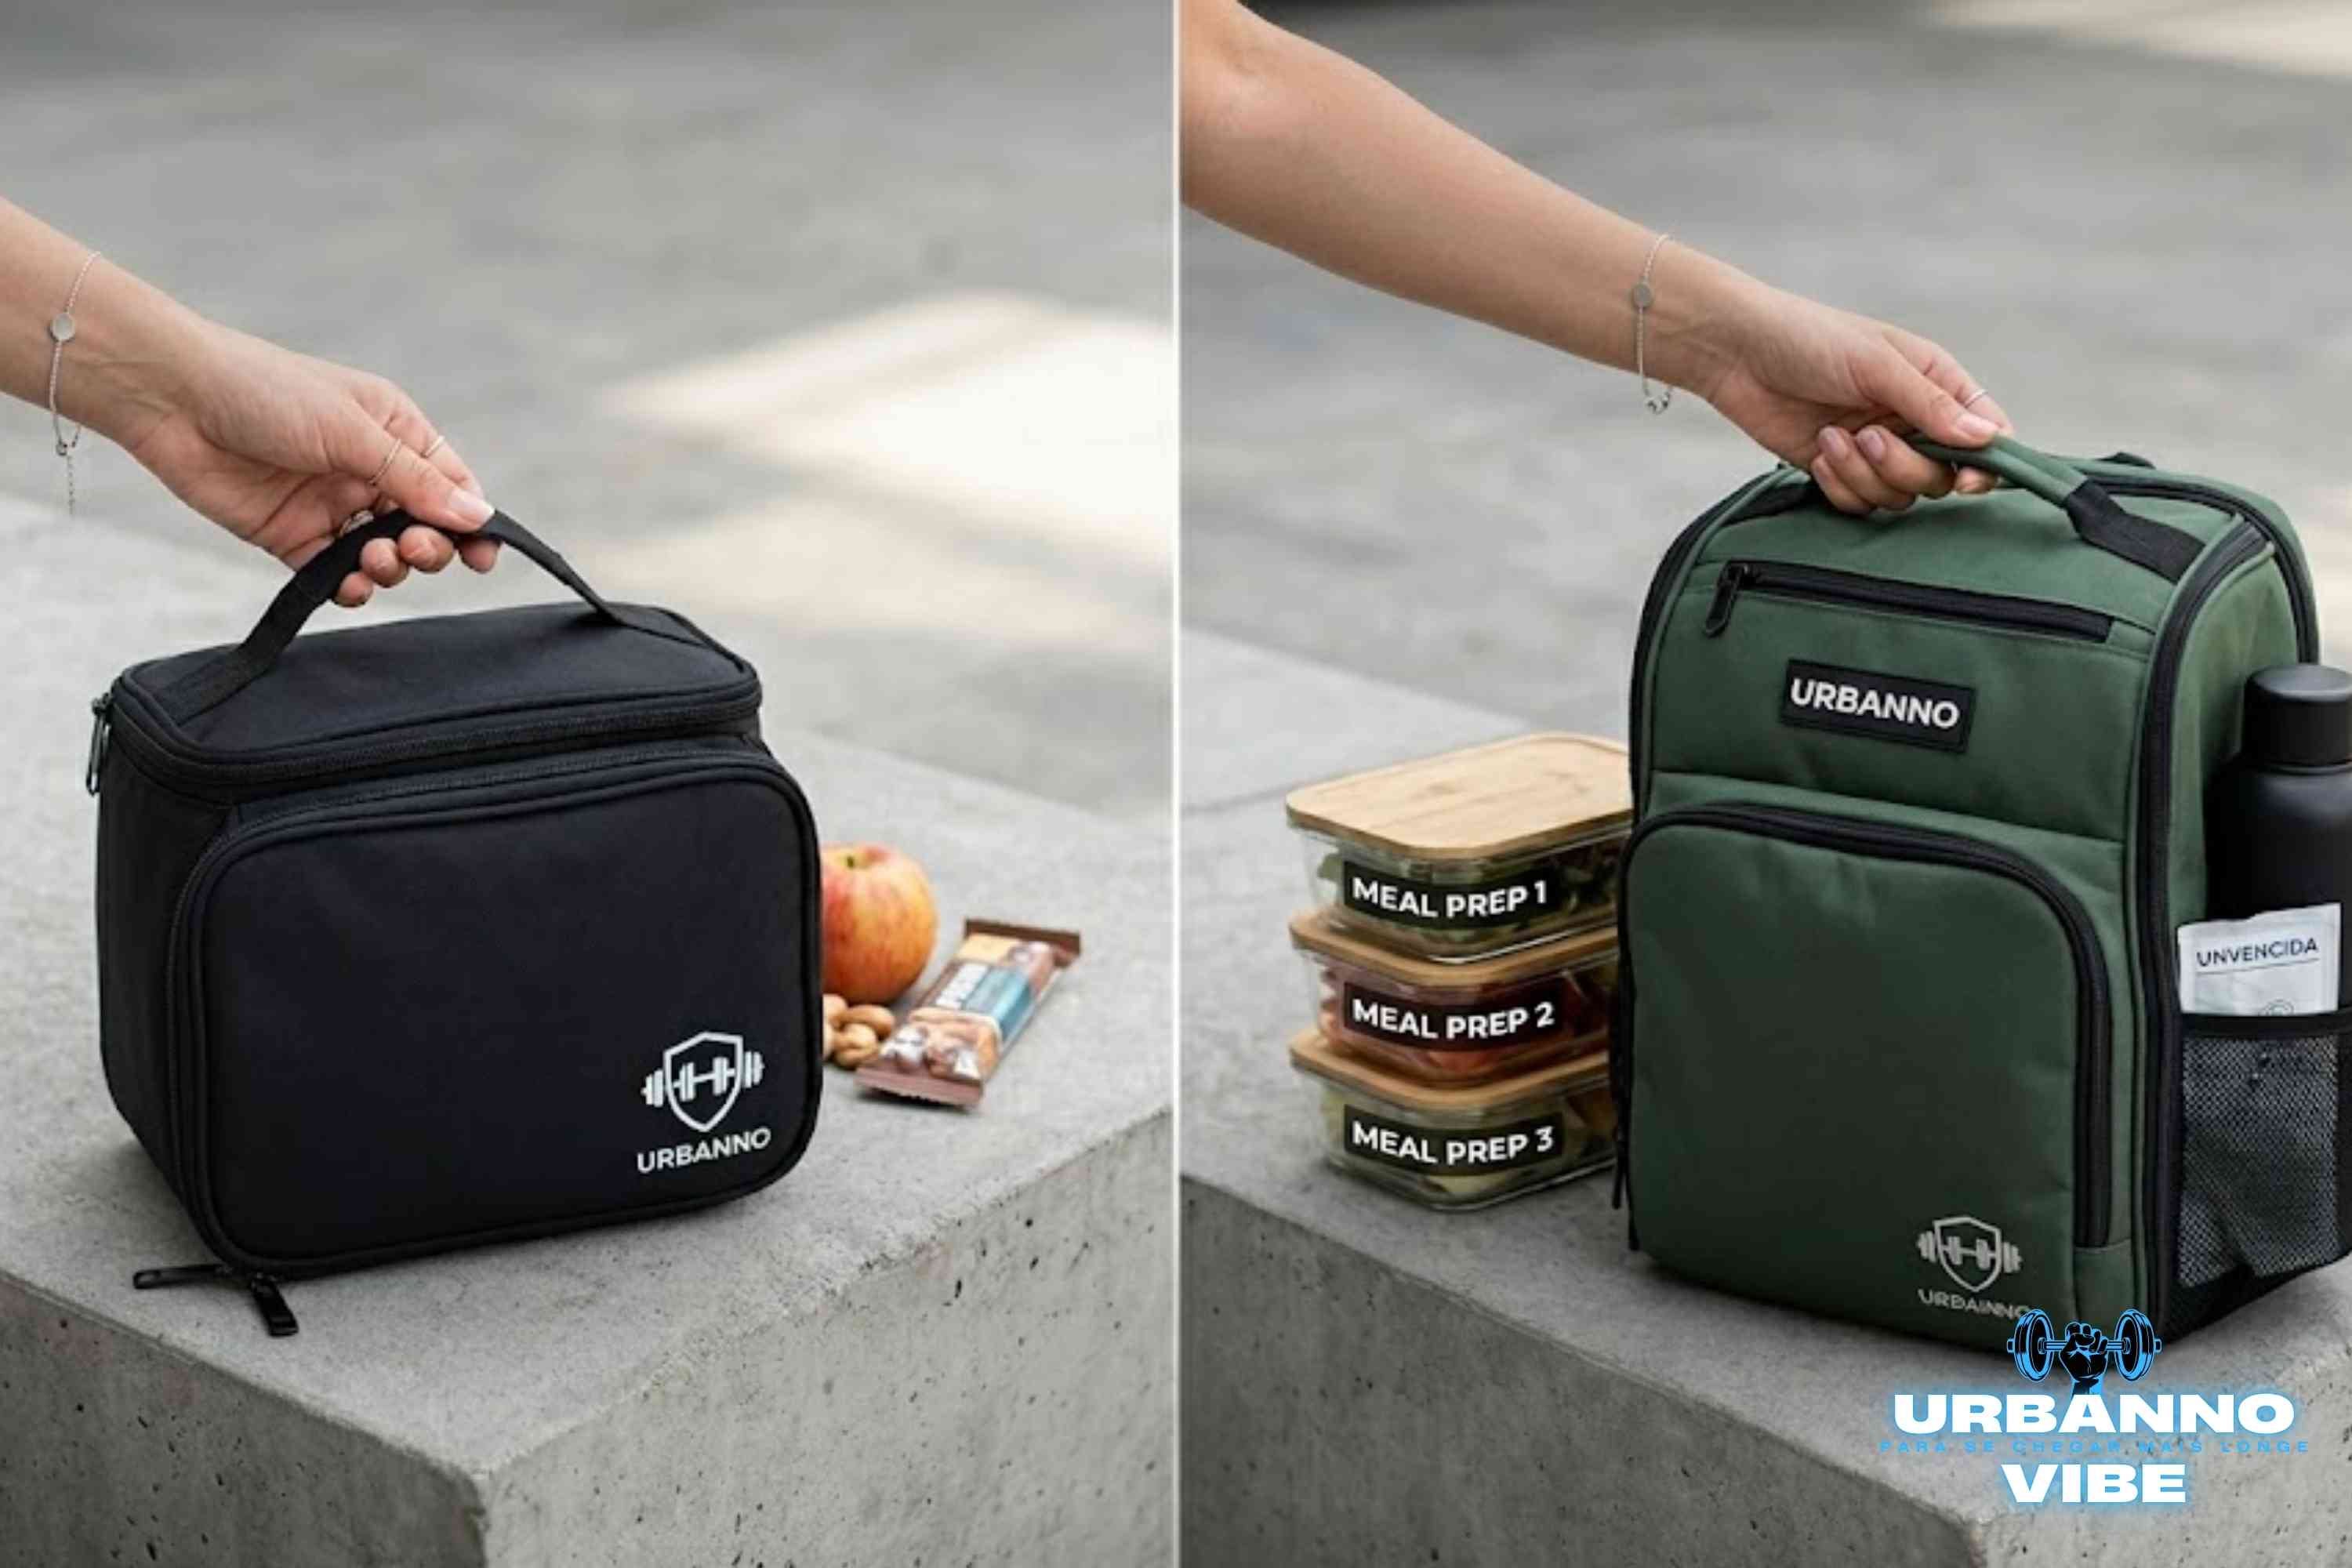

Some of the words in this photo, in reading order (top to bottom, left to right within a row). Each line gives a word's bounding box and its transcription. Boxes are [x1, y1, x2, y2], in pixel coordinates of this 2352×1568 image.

[1790, 677, 1960, 729] URBANNO
[1352, 877, 1438, 917] MEAL
[1446, 887, 1528, 918] PREP
[1534, 880, 1547, 904] 1
[2196, 938, 2318, 967] UNVENCIDA
[1352, 999, 1438, 1039] MEAL
[1446, 1008, 1528, 1039] PREP
[1534, 1002, 1555, 1028] 2
[637, 1127, 771, 1174] URBANNO
[1352, 1121, 1438, 1162] MEAL
[1446, 1134, 1528, 1165] PREP
[1534, 1126, 1553, 1152] 3
